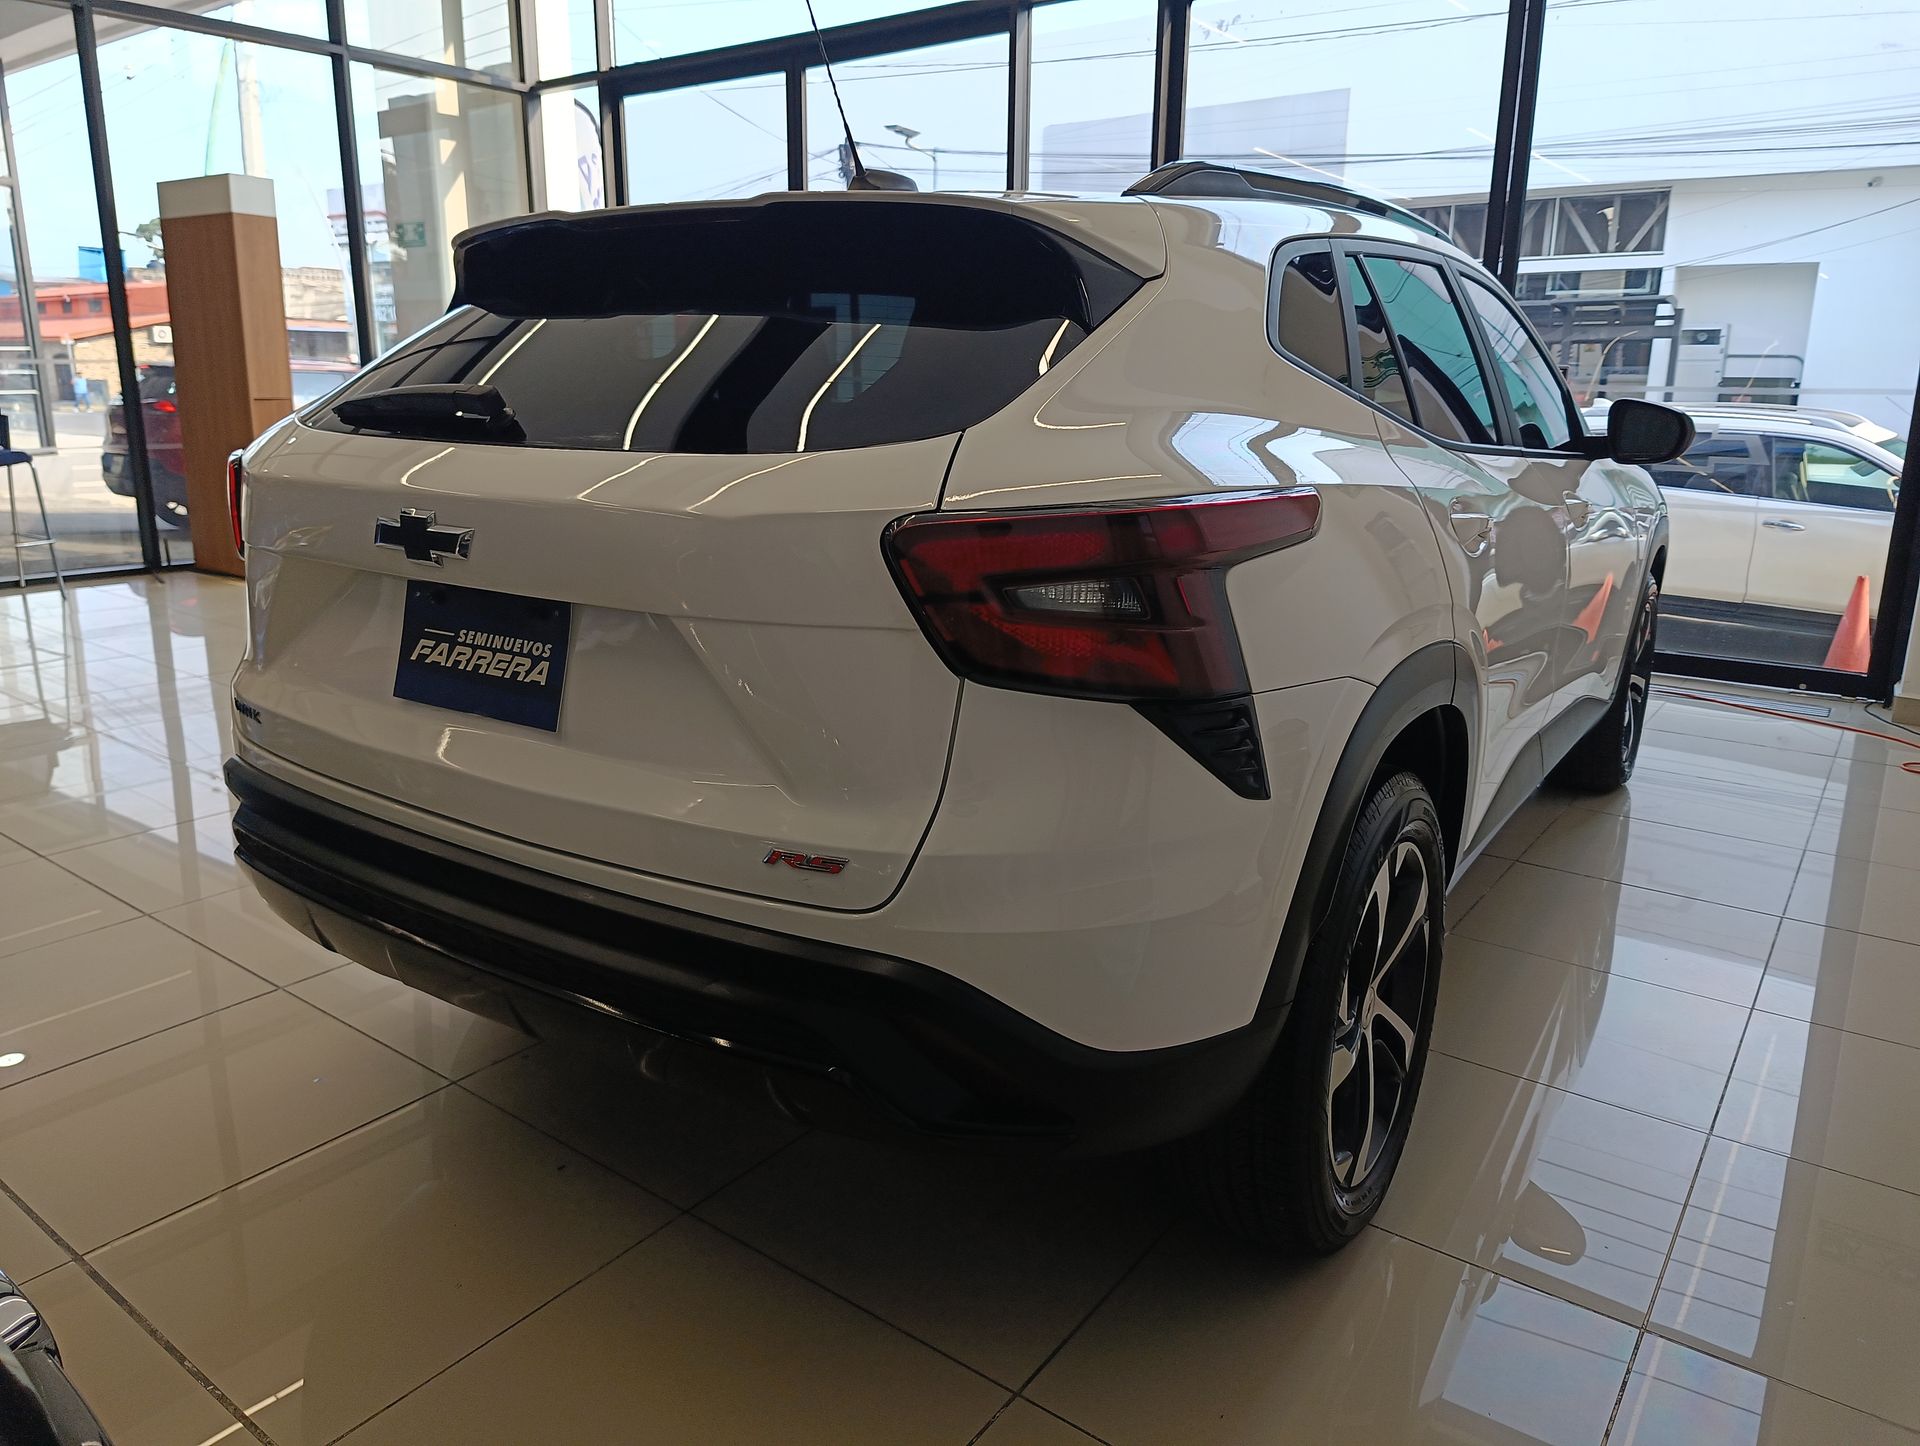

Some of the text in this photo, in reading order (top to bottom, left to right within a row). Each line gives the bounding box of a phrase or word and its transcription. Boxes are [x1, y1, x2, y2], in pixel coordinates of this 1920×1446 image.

[457, 629, 553, 657] SEMINUEVOS
[410, 638, 550, 685] FARRERA
[762, 848, 850, 875] RS
